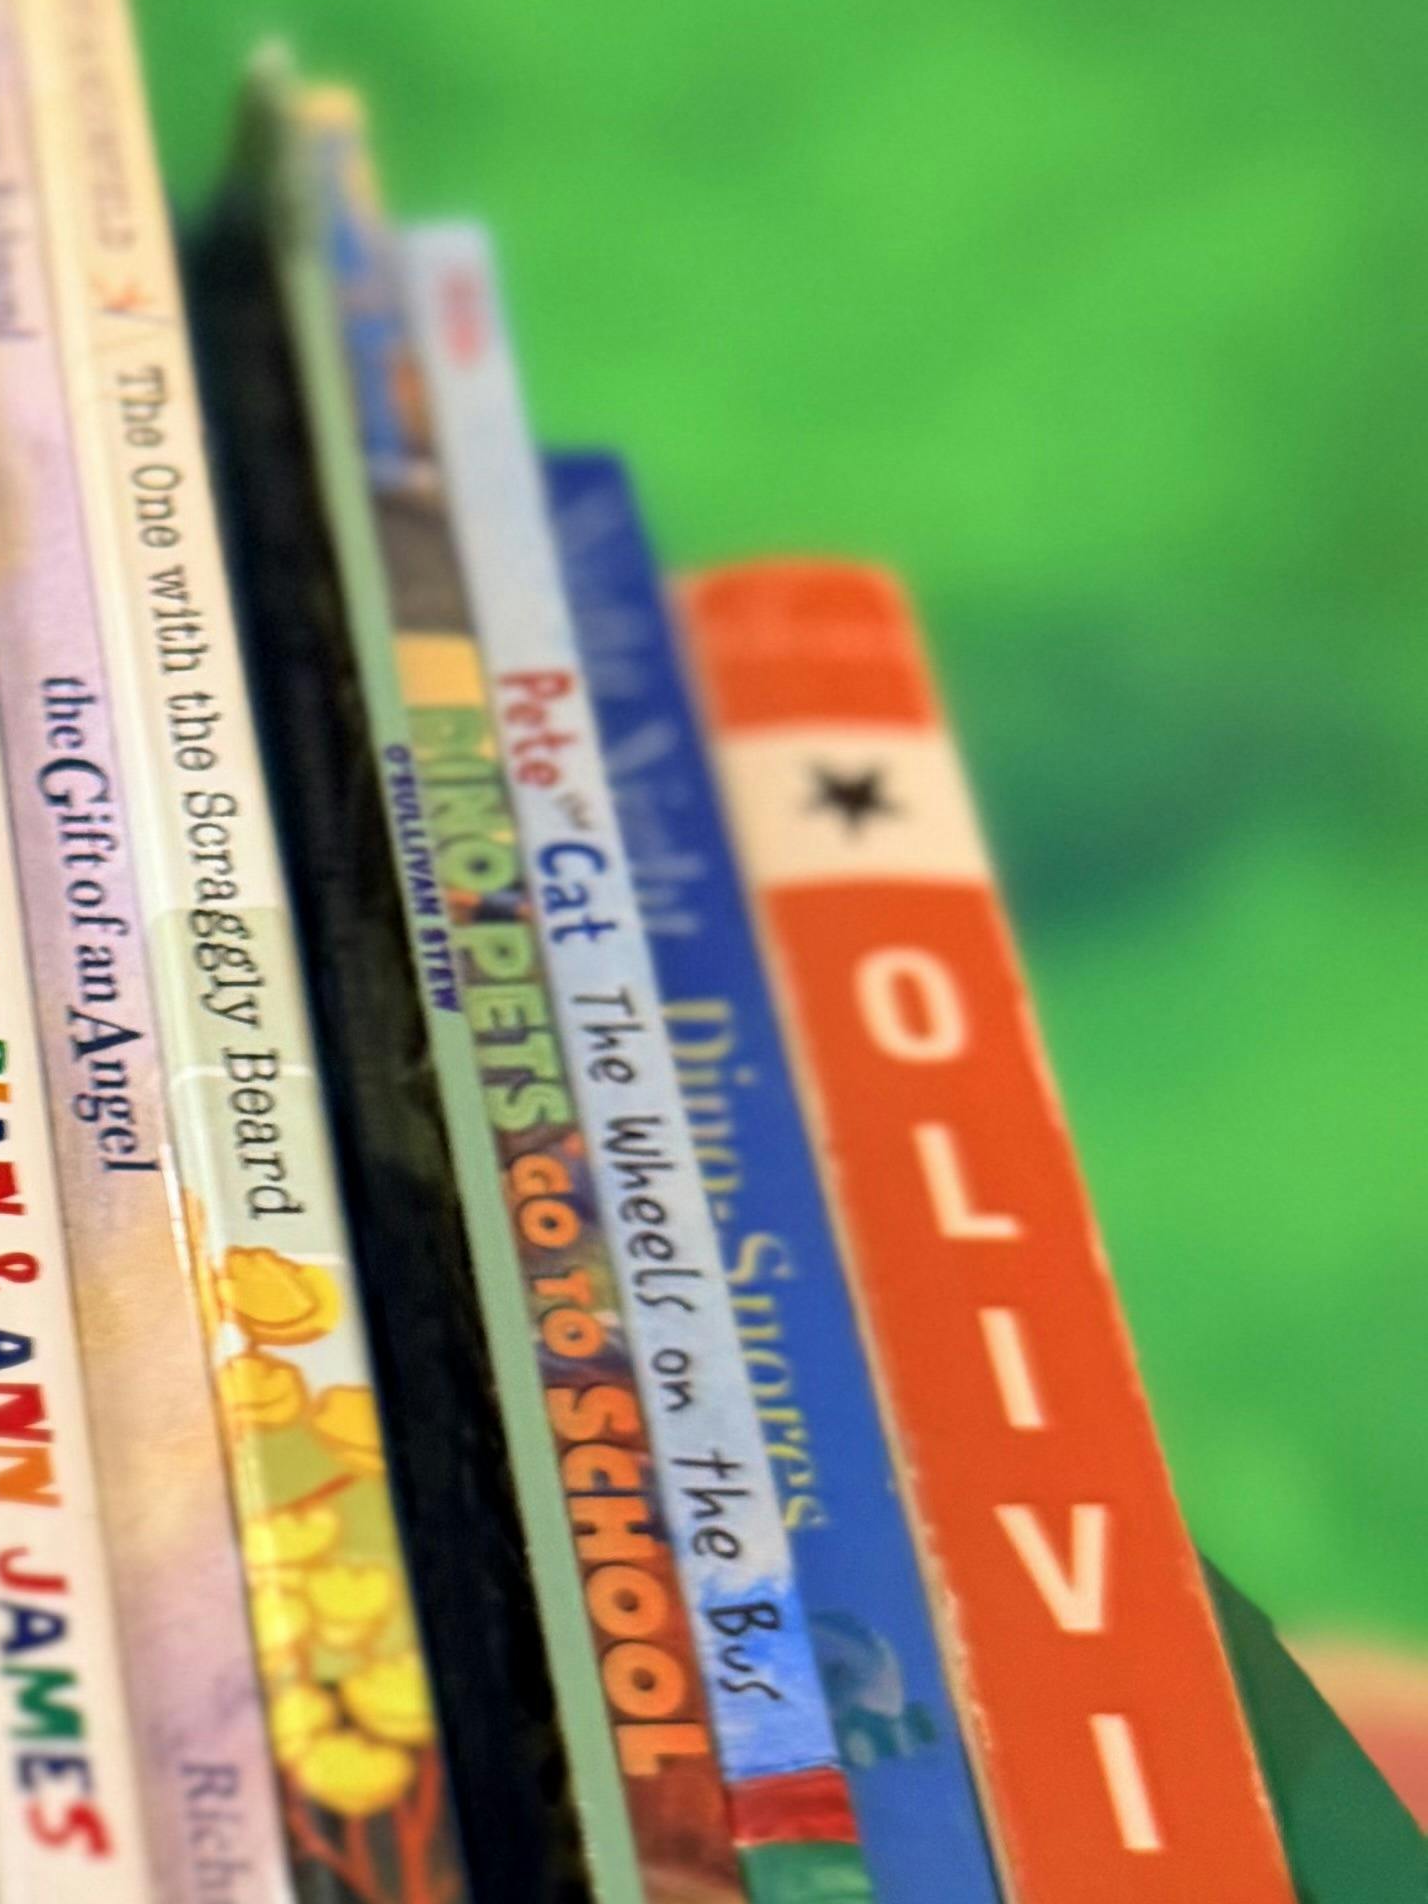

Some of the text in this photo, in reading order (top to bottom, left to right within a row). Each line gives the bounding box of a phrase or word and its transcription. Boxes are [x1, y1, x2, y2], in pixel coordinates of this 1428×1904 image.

[498, 666, 578, 790] Pete
[116, 364, 307, 1222] The One with the Scraggly Beard
[34, 673, 160, 1176] the Gift of an Angel
[380, 742, 463, 1015] O'SULLIVAN STEW
[536, 841, 618, 946] Cat
[573, 988, 641, 1086] The
[406, 706, 713, 1778] DINO PETS GO TO SCHOOL
[601, 1113, 705, 1313] Wheels
[652, 1348, 697, 1413] on
[669, 1449, 751, 1562] the
[705, 1599, 781, 1704] Bus
